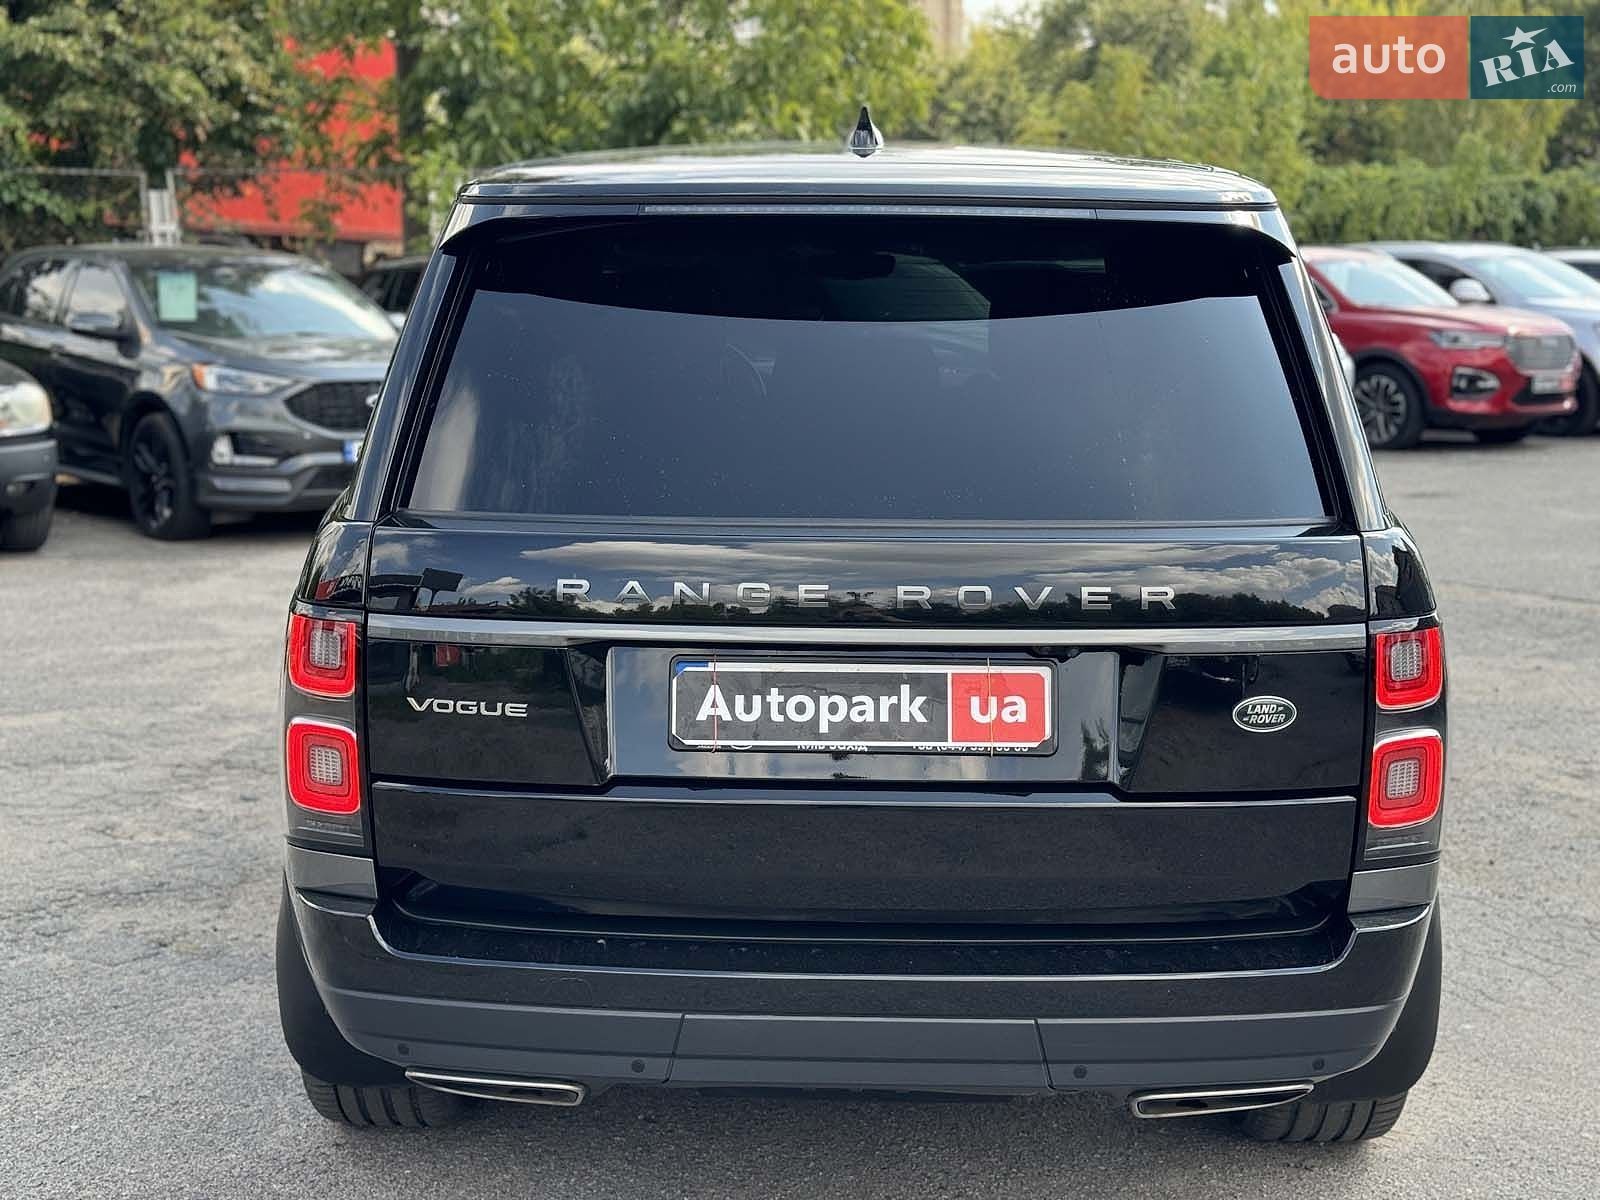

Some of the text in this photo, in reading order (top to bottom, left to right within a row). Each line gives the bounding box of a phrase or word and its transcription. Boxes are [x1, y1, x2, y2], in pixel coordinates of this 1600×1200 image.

[556, 578, 1177, 610] RANGE ROVER
[406, 697, 528, 717] VOGUE
[695, 684, 1027, 733] Autopark ua
